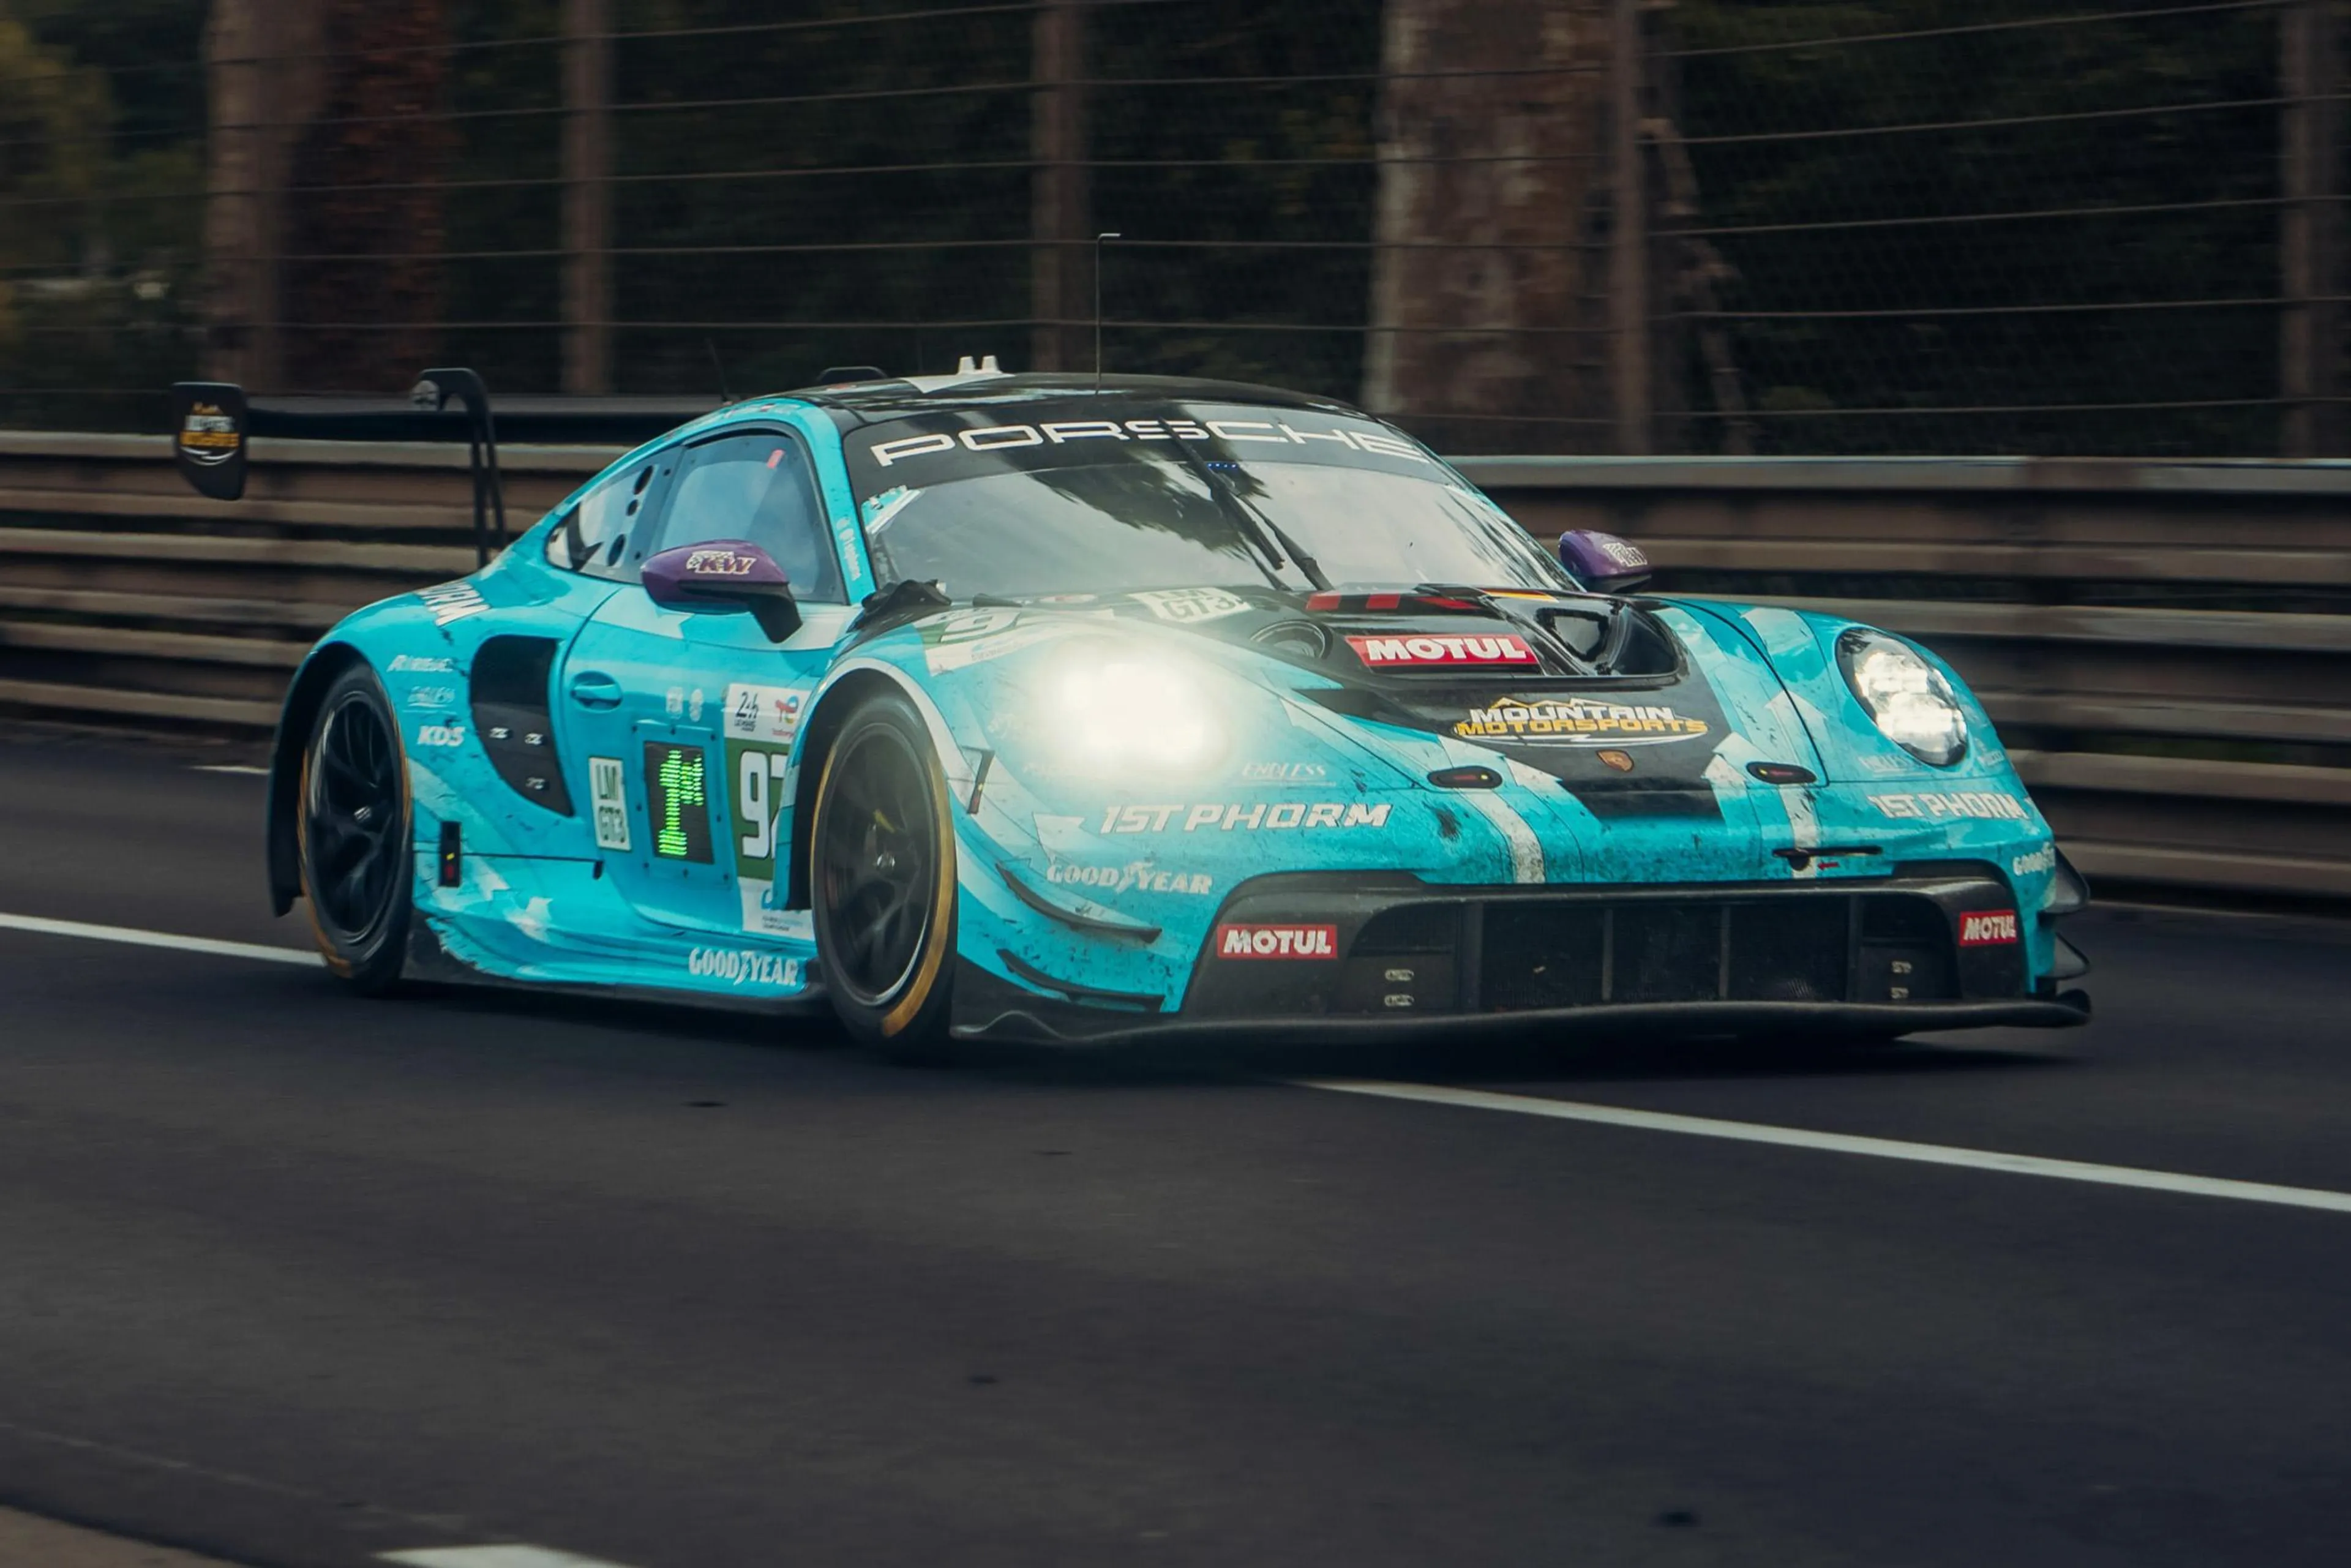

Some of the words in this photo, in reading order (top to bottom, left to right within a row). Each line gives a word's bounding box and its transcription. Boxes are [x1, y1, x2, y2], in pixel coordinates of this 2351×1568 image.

[871, 420, 1432, 467] PORSCHE
[1162, 596, 1237, 620] GT3
[1368, 637, 1527, 661] MOTUL
[1457, 719, 1708, 735] MOTORSPORTS
[1469, 705, 1677, 723] MOUNTAIN
[1101, 803, 1185, 834] 1ST
[1183, 803, 1393, 831] PHORM
[1867, 794, 1925, 819] 1ST
[1918, 793, 2031, 820] PHORM
[1046, 861, 1213, 895] GOODYEAR
[1962, 915, 2016, 941] MOTUL
[1223, 929, 1332, 955] MOTUL
[688, 947, 799, 986] GOODYEAR
